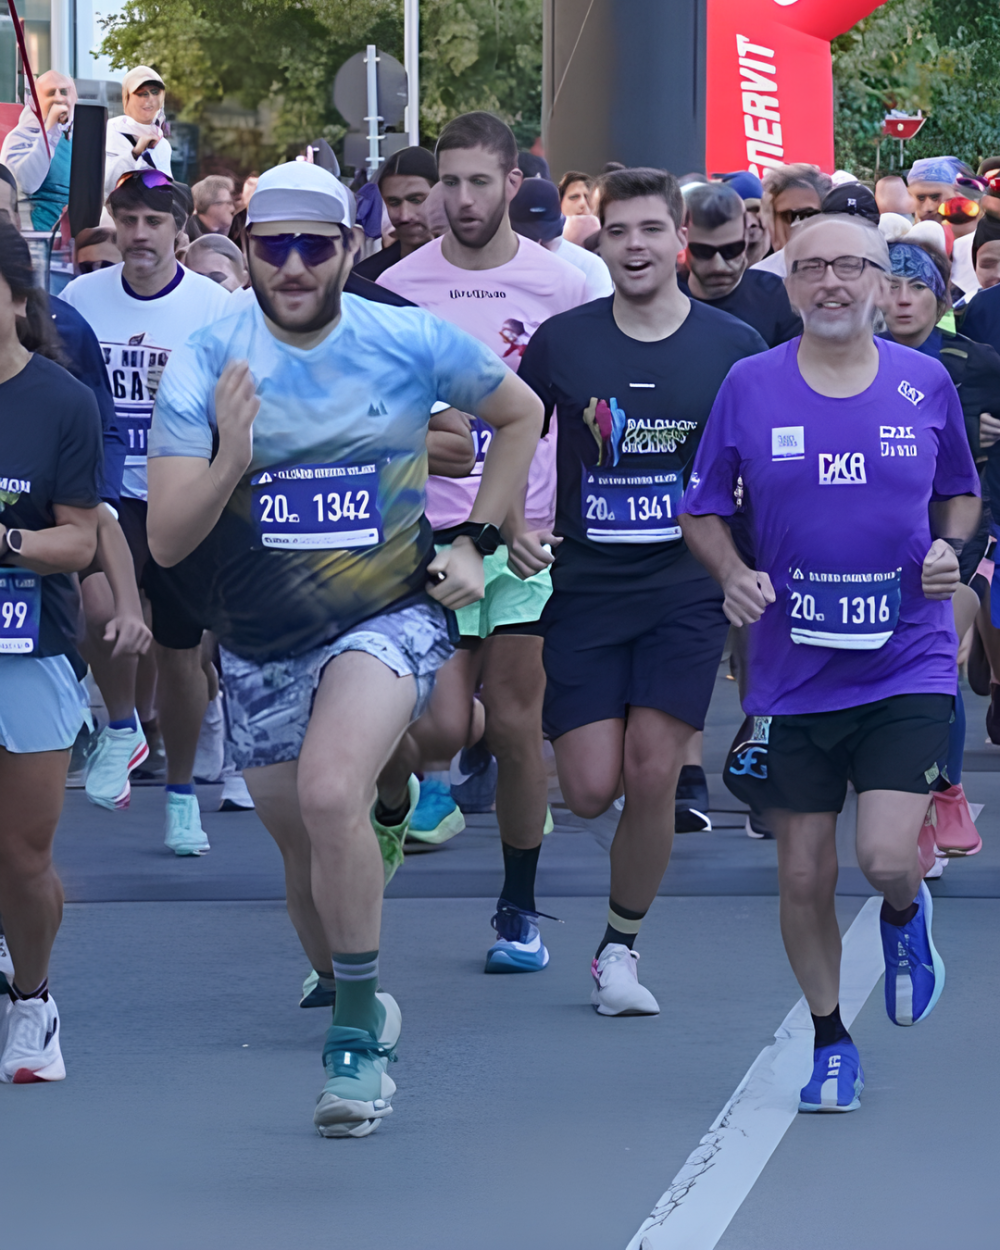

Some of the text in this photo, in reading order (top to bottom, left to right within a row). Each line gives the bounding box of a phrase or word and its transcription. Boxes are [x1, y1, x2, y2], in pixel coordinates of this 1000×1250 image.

[312, 490, 371, 523] 1342
[627, 494, 672, 521] 1341
[2, 602, 28, 629] 99
[839, 595, 890, 624] 1316
